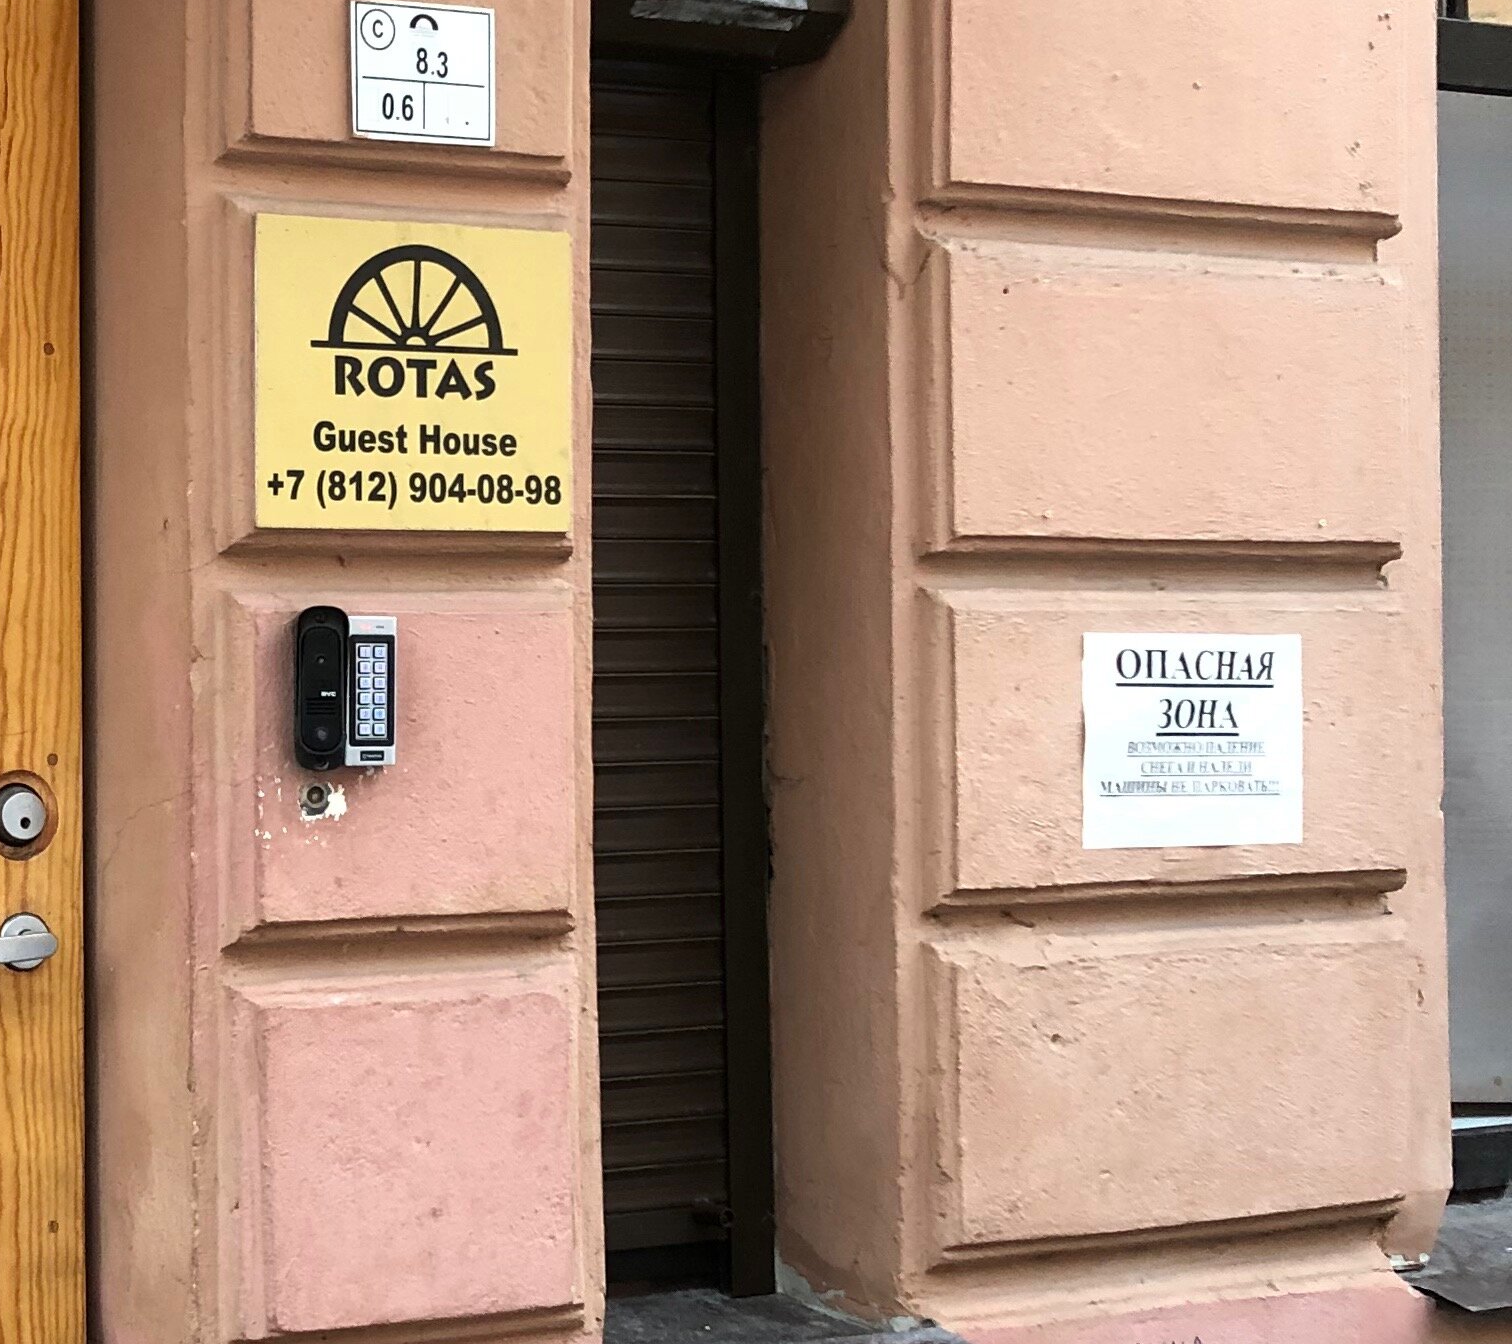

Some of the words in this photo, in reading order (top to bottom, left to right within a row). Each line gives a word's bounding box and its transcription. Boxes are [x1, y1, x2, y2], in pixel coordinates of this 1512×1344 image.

[416, 47, 448, 78] 8.3
[382, 92, 414, 121] 0.6
[334, 354, 496, 401] ROTAS
[313, 420, 408, 454] Guest
[419, 424, 518, 457] House
[267, 469, 305, 500] +7
[316, 470, 398, 510] (812)
[408, 473, 562, 506] 904-08-98
[1115, 648, 1275, 681] ОПАСНАЯ
[1158, 698, 1238, 729] ЗОНА
